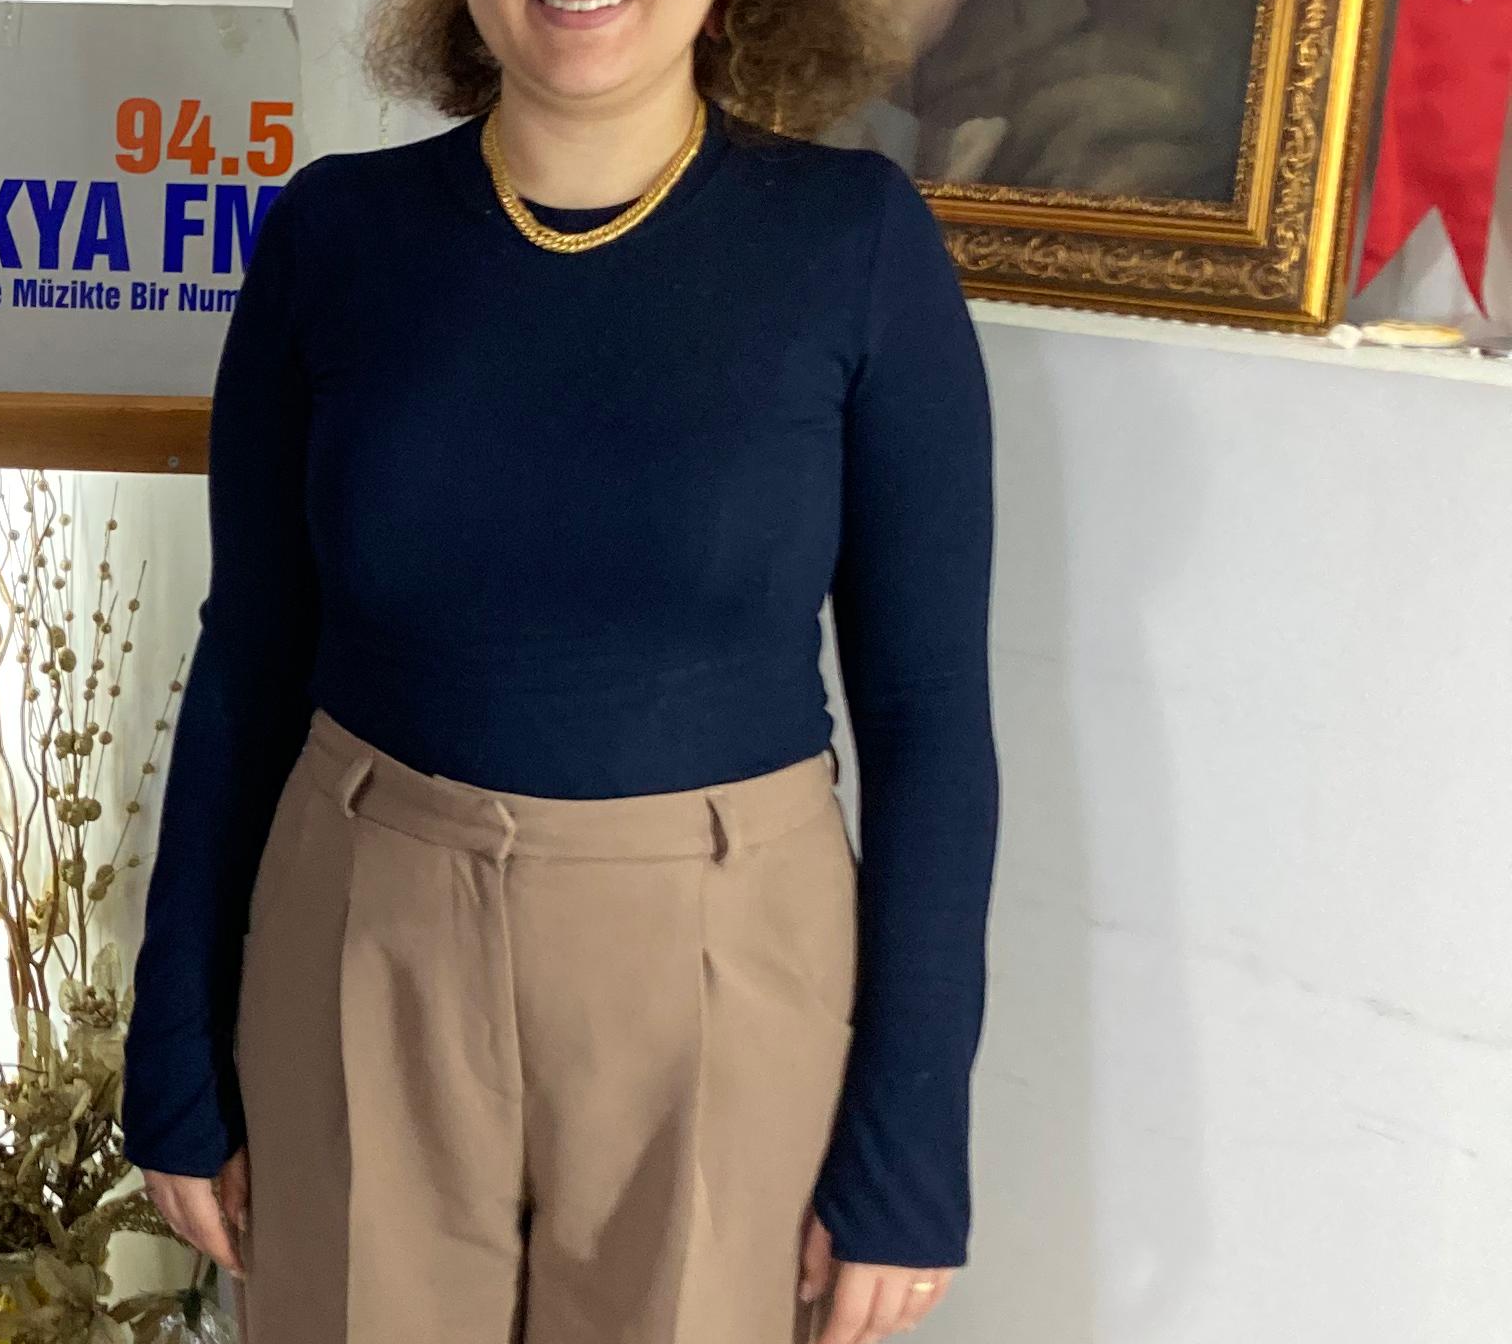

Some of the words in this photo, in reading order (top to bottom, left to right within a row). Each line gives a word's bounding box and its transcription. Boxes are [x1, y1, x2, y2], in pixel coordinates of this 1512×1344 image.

[115, 97, 294, 177] 94.5
[162, 182, 283, 274] FM
[13, 278, 120, 310] Müzikte
[130, 281, 169, 311] Bir
